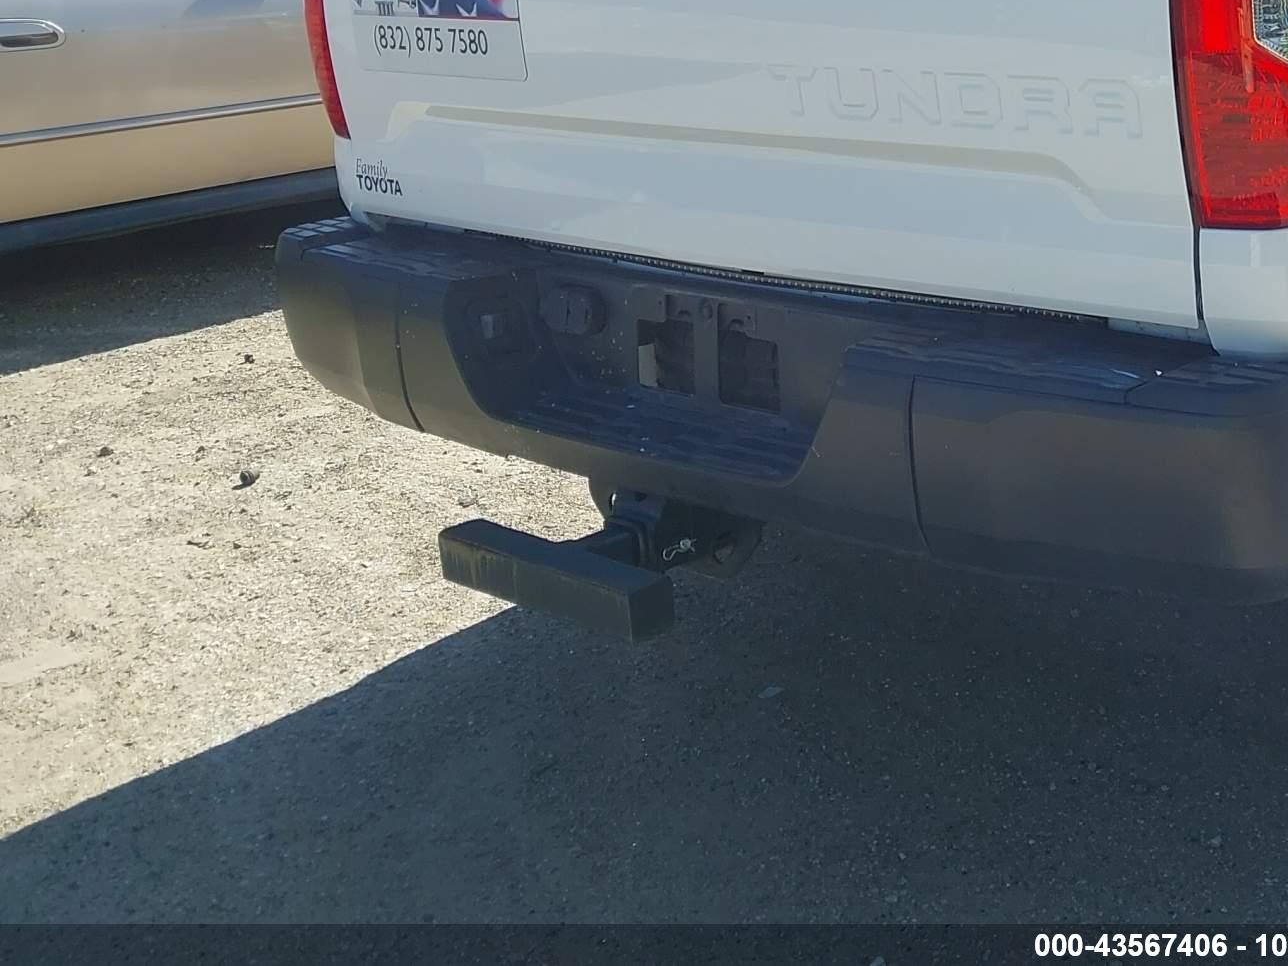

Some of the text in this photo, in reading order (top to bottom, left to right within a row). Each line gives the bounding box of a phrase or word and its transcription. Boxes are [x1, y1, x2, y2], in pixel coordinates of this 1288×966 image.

[373, 24, 489, 58] (832) 875 7580
[766, 62, 1143, 139] TUNDRA
[355, 157, 388, 179] Family
[355, 174, 403, 196] TOYOTA
